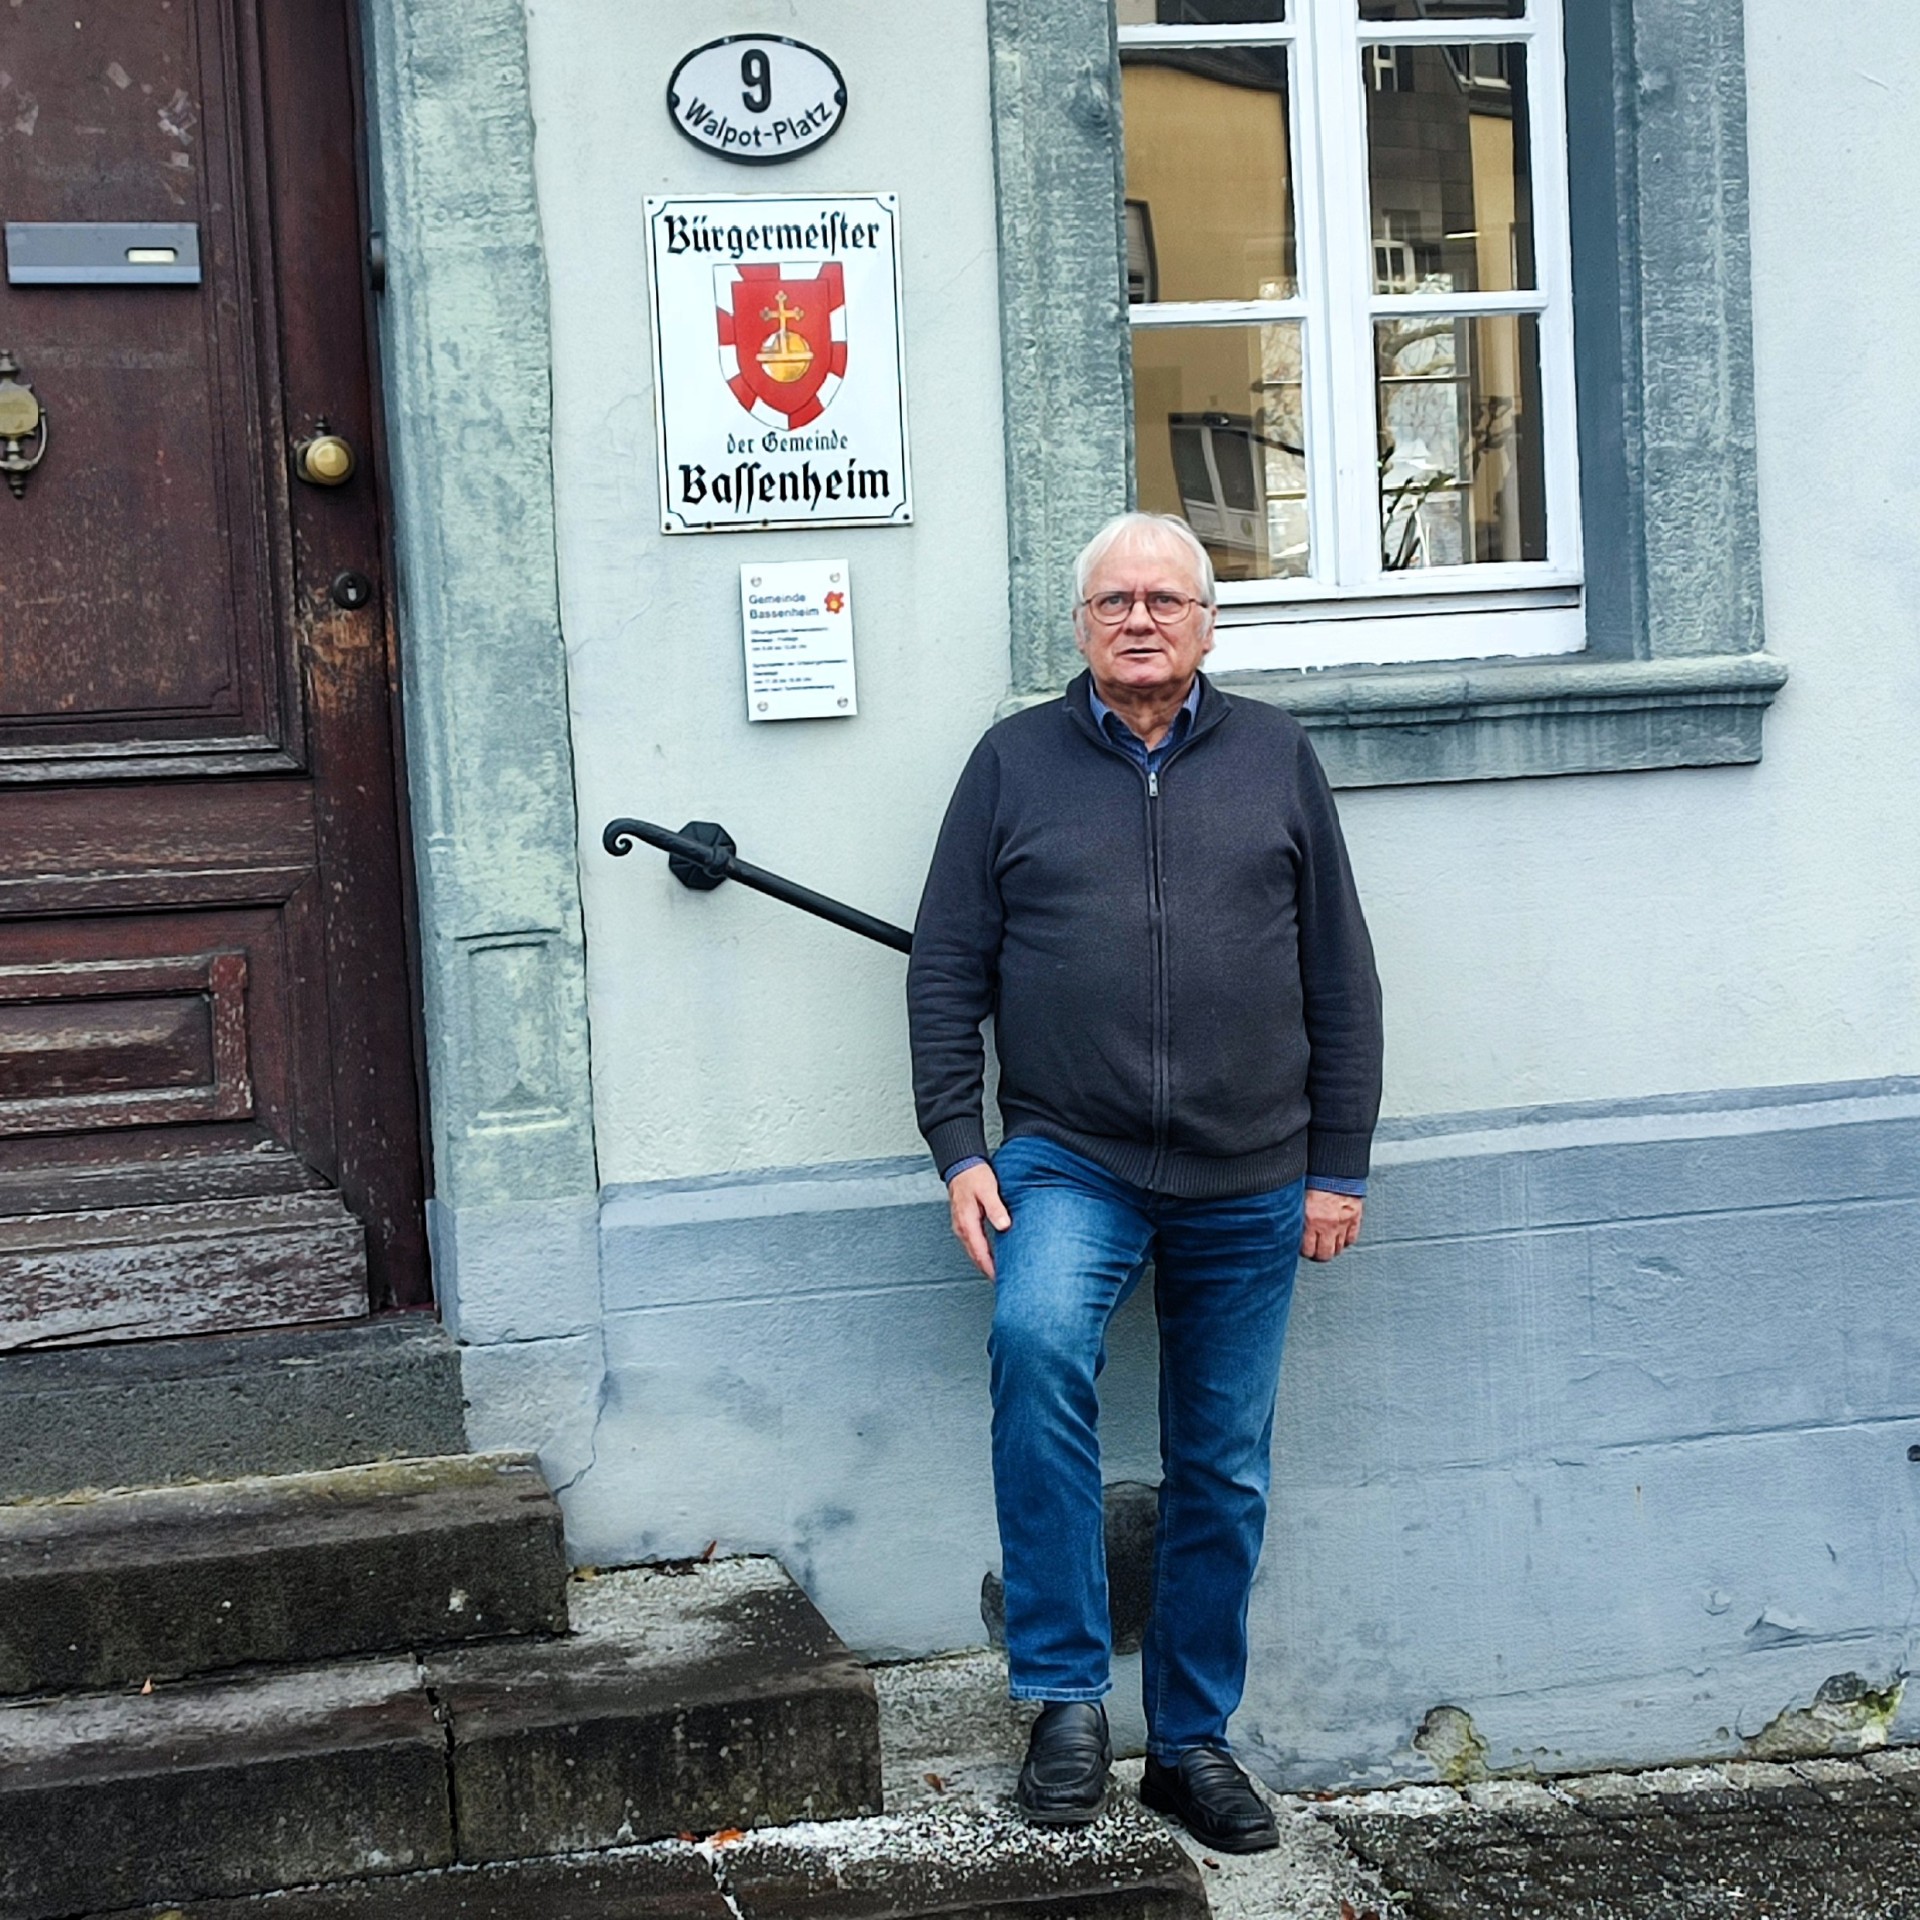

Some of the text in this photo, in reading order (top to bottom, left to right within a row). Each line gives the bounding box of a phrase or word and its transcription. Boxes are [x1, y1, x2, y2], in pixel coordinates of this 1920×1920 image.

[741, 48, 772, 113] 9
[684, 96, 832, 147] Walpot-Platz
[727, 429, 848, 454] der Gemeinde
[749, 593, 806, 604] Gemeinde
[749, 608, 819, 619] Bassenheim
